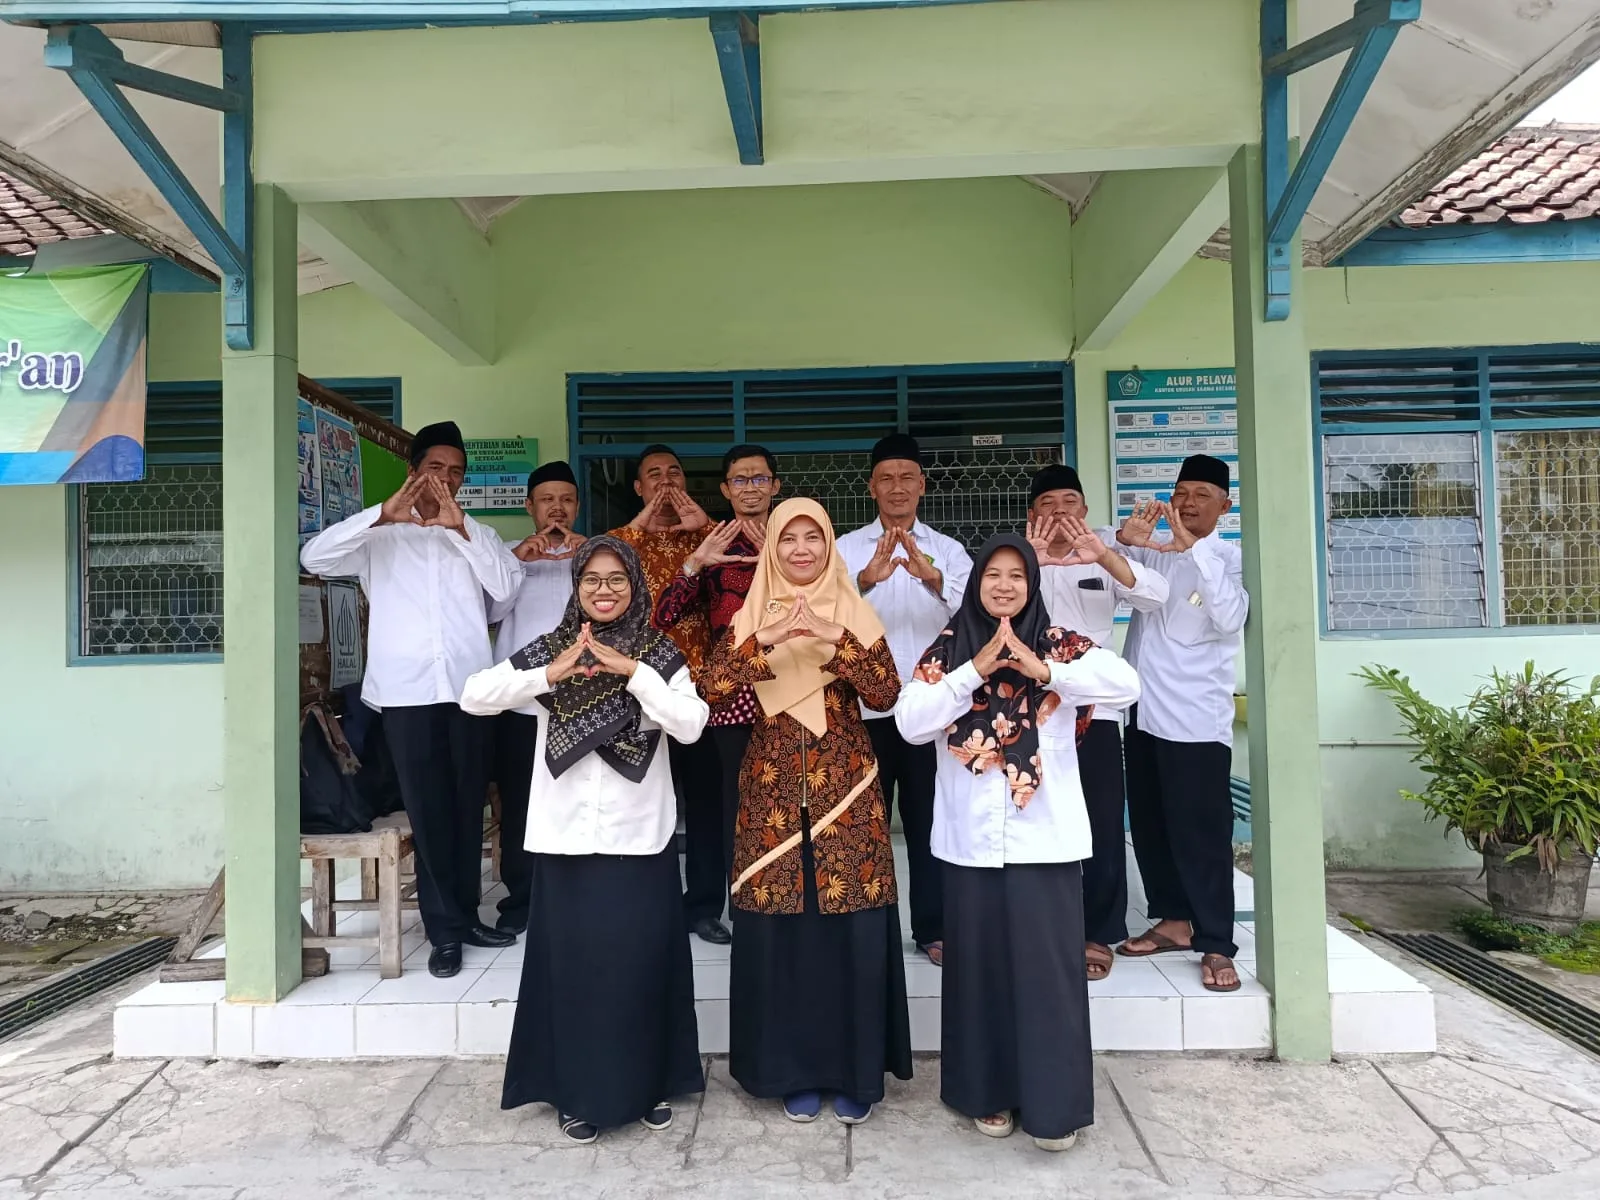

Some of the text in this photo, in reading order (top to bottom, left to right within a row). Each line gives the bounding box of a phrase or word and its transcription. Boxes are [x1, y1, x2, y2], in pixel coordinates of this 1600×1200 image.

[0, 339, 83, 392] 'an
[1166, 376, 1193, 386] ALUR
[464, 441, 524, 449] MENTERIAN AGAMA
[337, 658, 357, 669] HALAL
